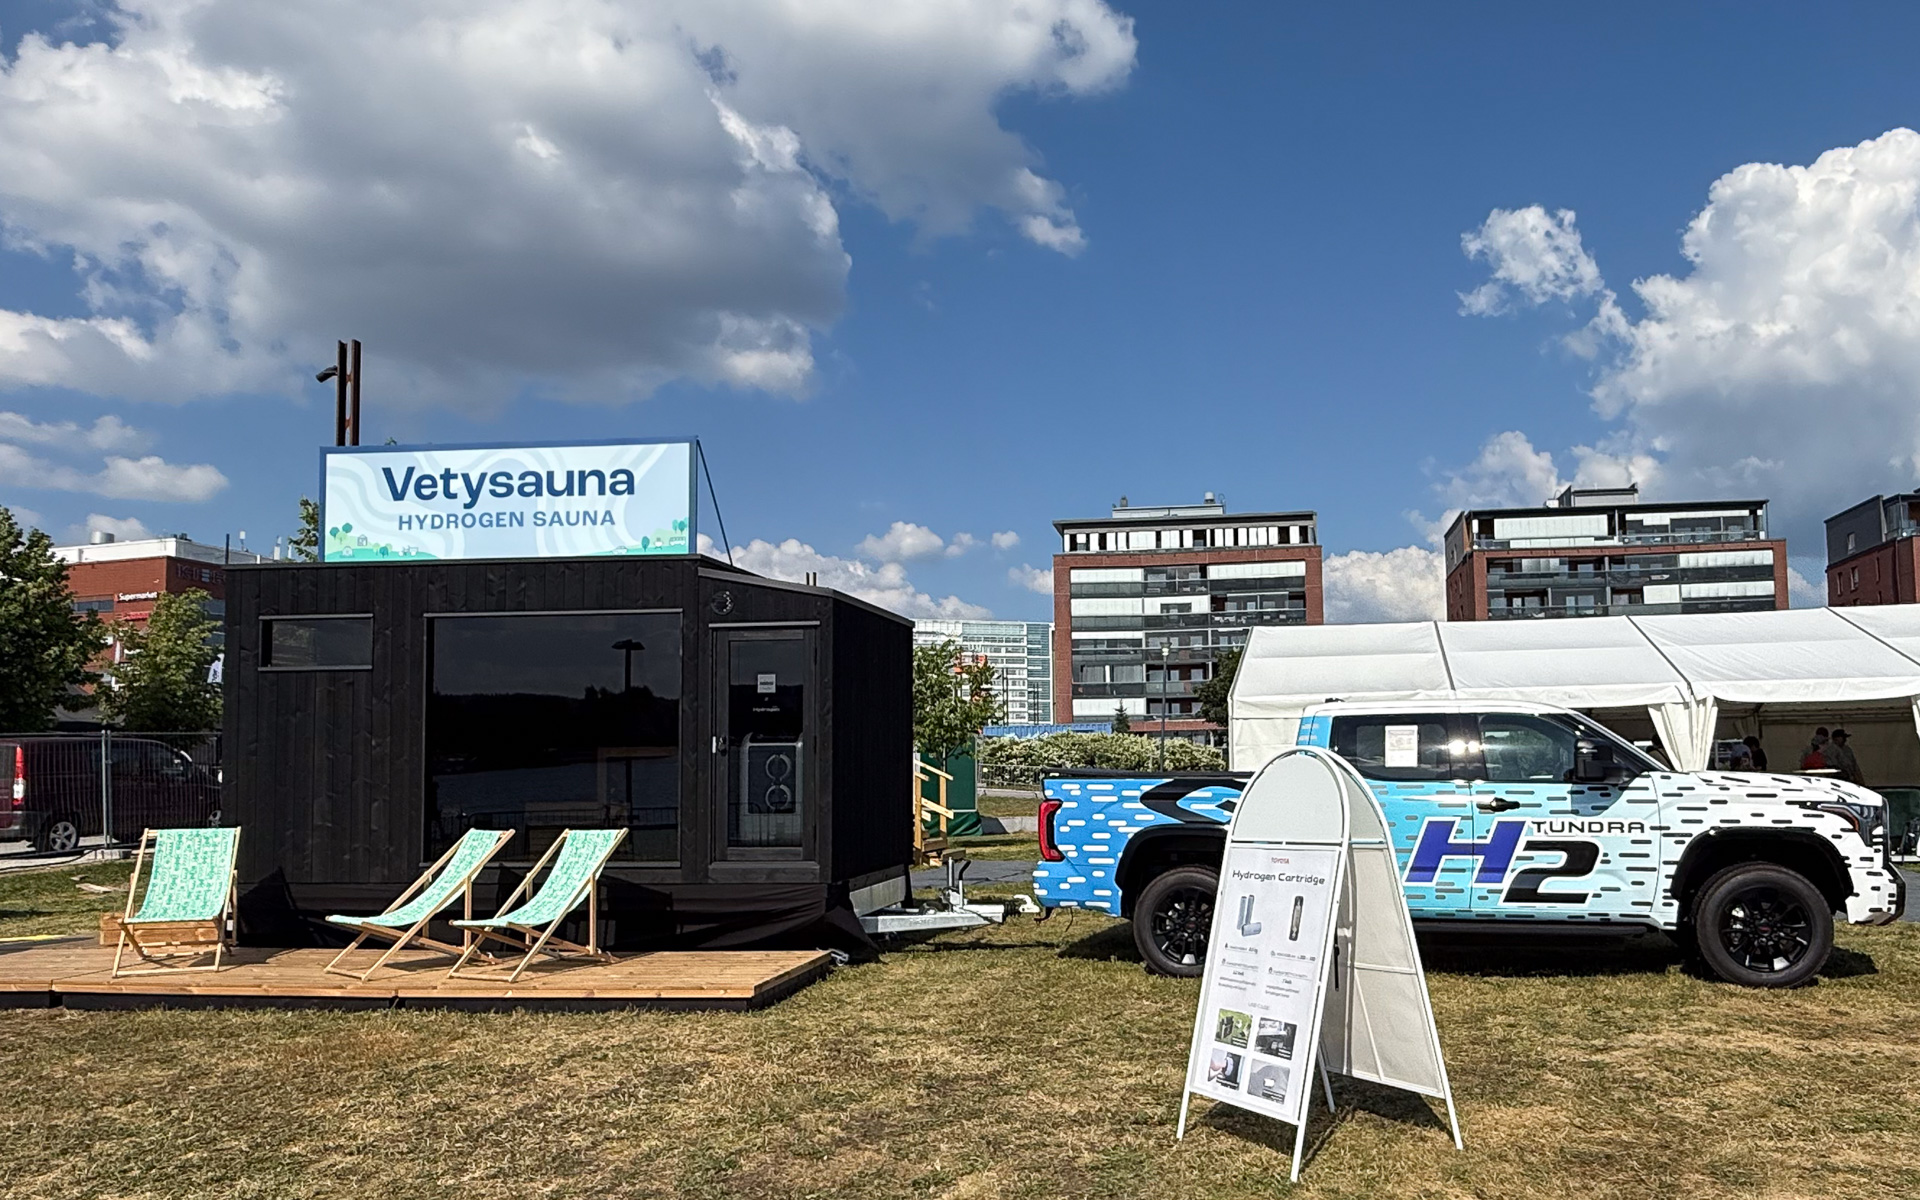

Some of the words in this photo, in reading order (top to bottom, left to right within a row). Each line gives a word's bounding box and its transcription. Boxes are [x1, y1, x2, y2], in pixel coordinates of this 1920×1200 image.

[382, 466, 635, 509] Vetysauna
[398, 511, 525, 531] HYDROGEN
[533, 510, 615, 527] SAUNA
[118, 591, 158, 601] Supermarket
[1532, 820, 1645, 834] TUNDRA
[1271, 857, 1290, 865] TOYOTA
[1403, 819, 1601, 904] H2
[1232, 870, 1276, 882] Hydrogen
[1278, 873, 1326, 886] Cartridge
